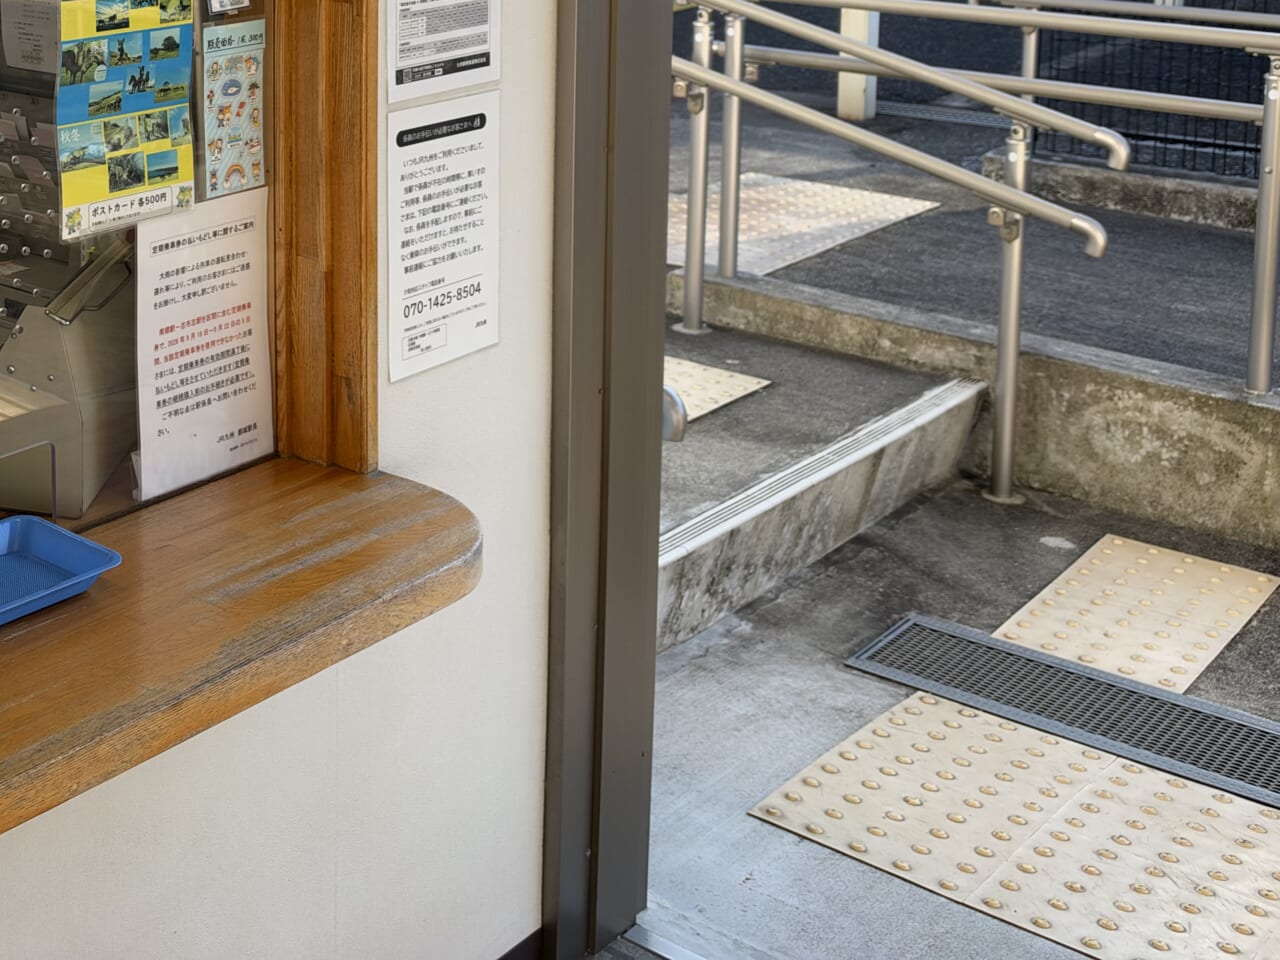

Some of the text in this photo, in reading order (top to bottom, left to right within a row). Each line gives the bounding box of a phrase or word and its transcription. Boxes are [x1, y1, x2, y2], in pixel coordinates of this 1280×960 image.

[91, 192, 167, 218] ポストカード 各500円
[403, 281, 482, 319] 070-1425-8504
